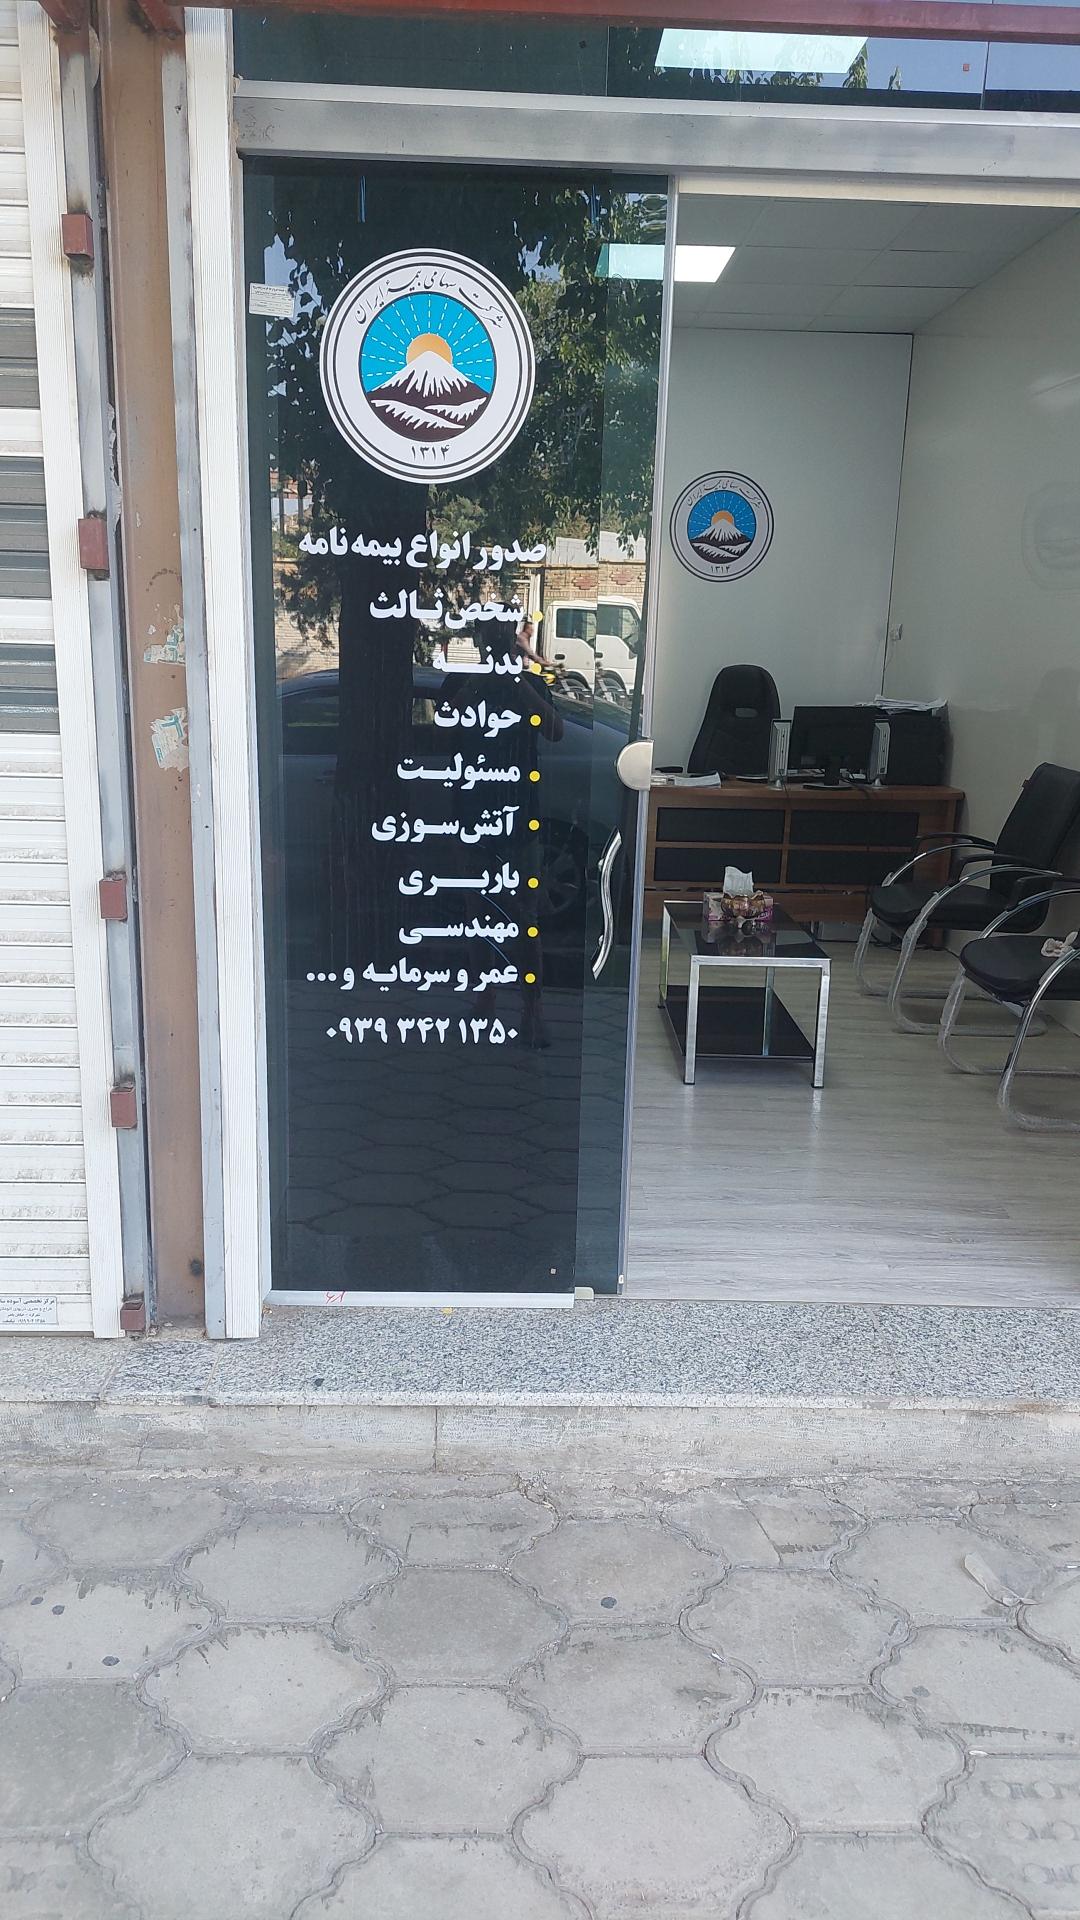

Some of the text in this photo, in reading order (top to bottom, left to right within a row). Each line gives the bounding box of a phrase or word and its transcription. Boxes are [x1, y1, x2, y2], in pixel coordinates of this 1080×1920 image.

[424, 270, 458, 289] سهامی
[354, 286, 384, 325] ایران
[458, 286, 505, 329] شرکت
[410, 444, 451, 462] ۱۳۱۴
[298, 526, 547, 571] صدور انواع بیمه نامه
[369, 588, 524, 630] شخص ثالث
[432, 644, 523, 683] بدنه
[434, 700, 522, 737] حوادث
[396, 752, 521, 790] مسئولیت
[398, 861, 520, 896] باربری
[398, 914, 519, 945] مهندسی
[362, 957, 451, 992] سرمایه
[453, 968, 468, 992] و
[472, 964, 519, 992] عمر
[326, 1017, 519, 1044] ۰۹۳۹ ۳۴۲ ۱۳۵۰
